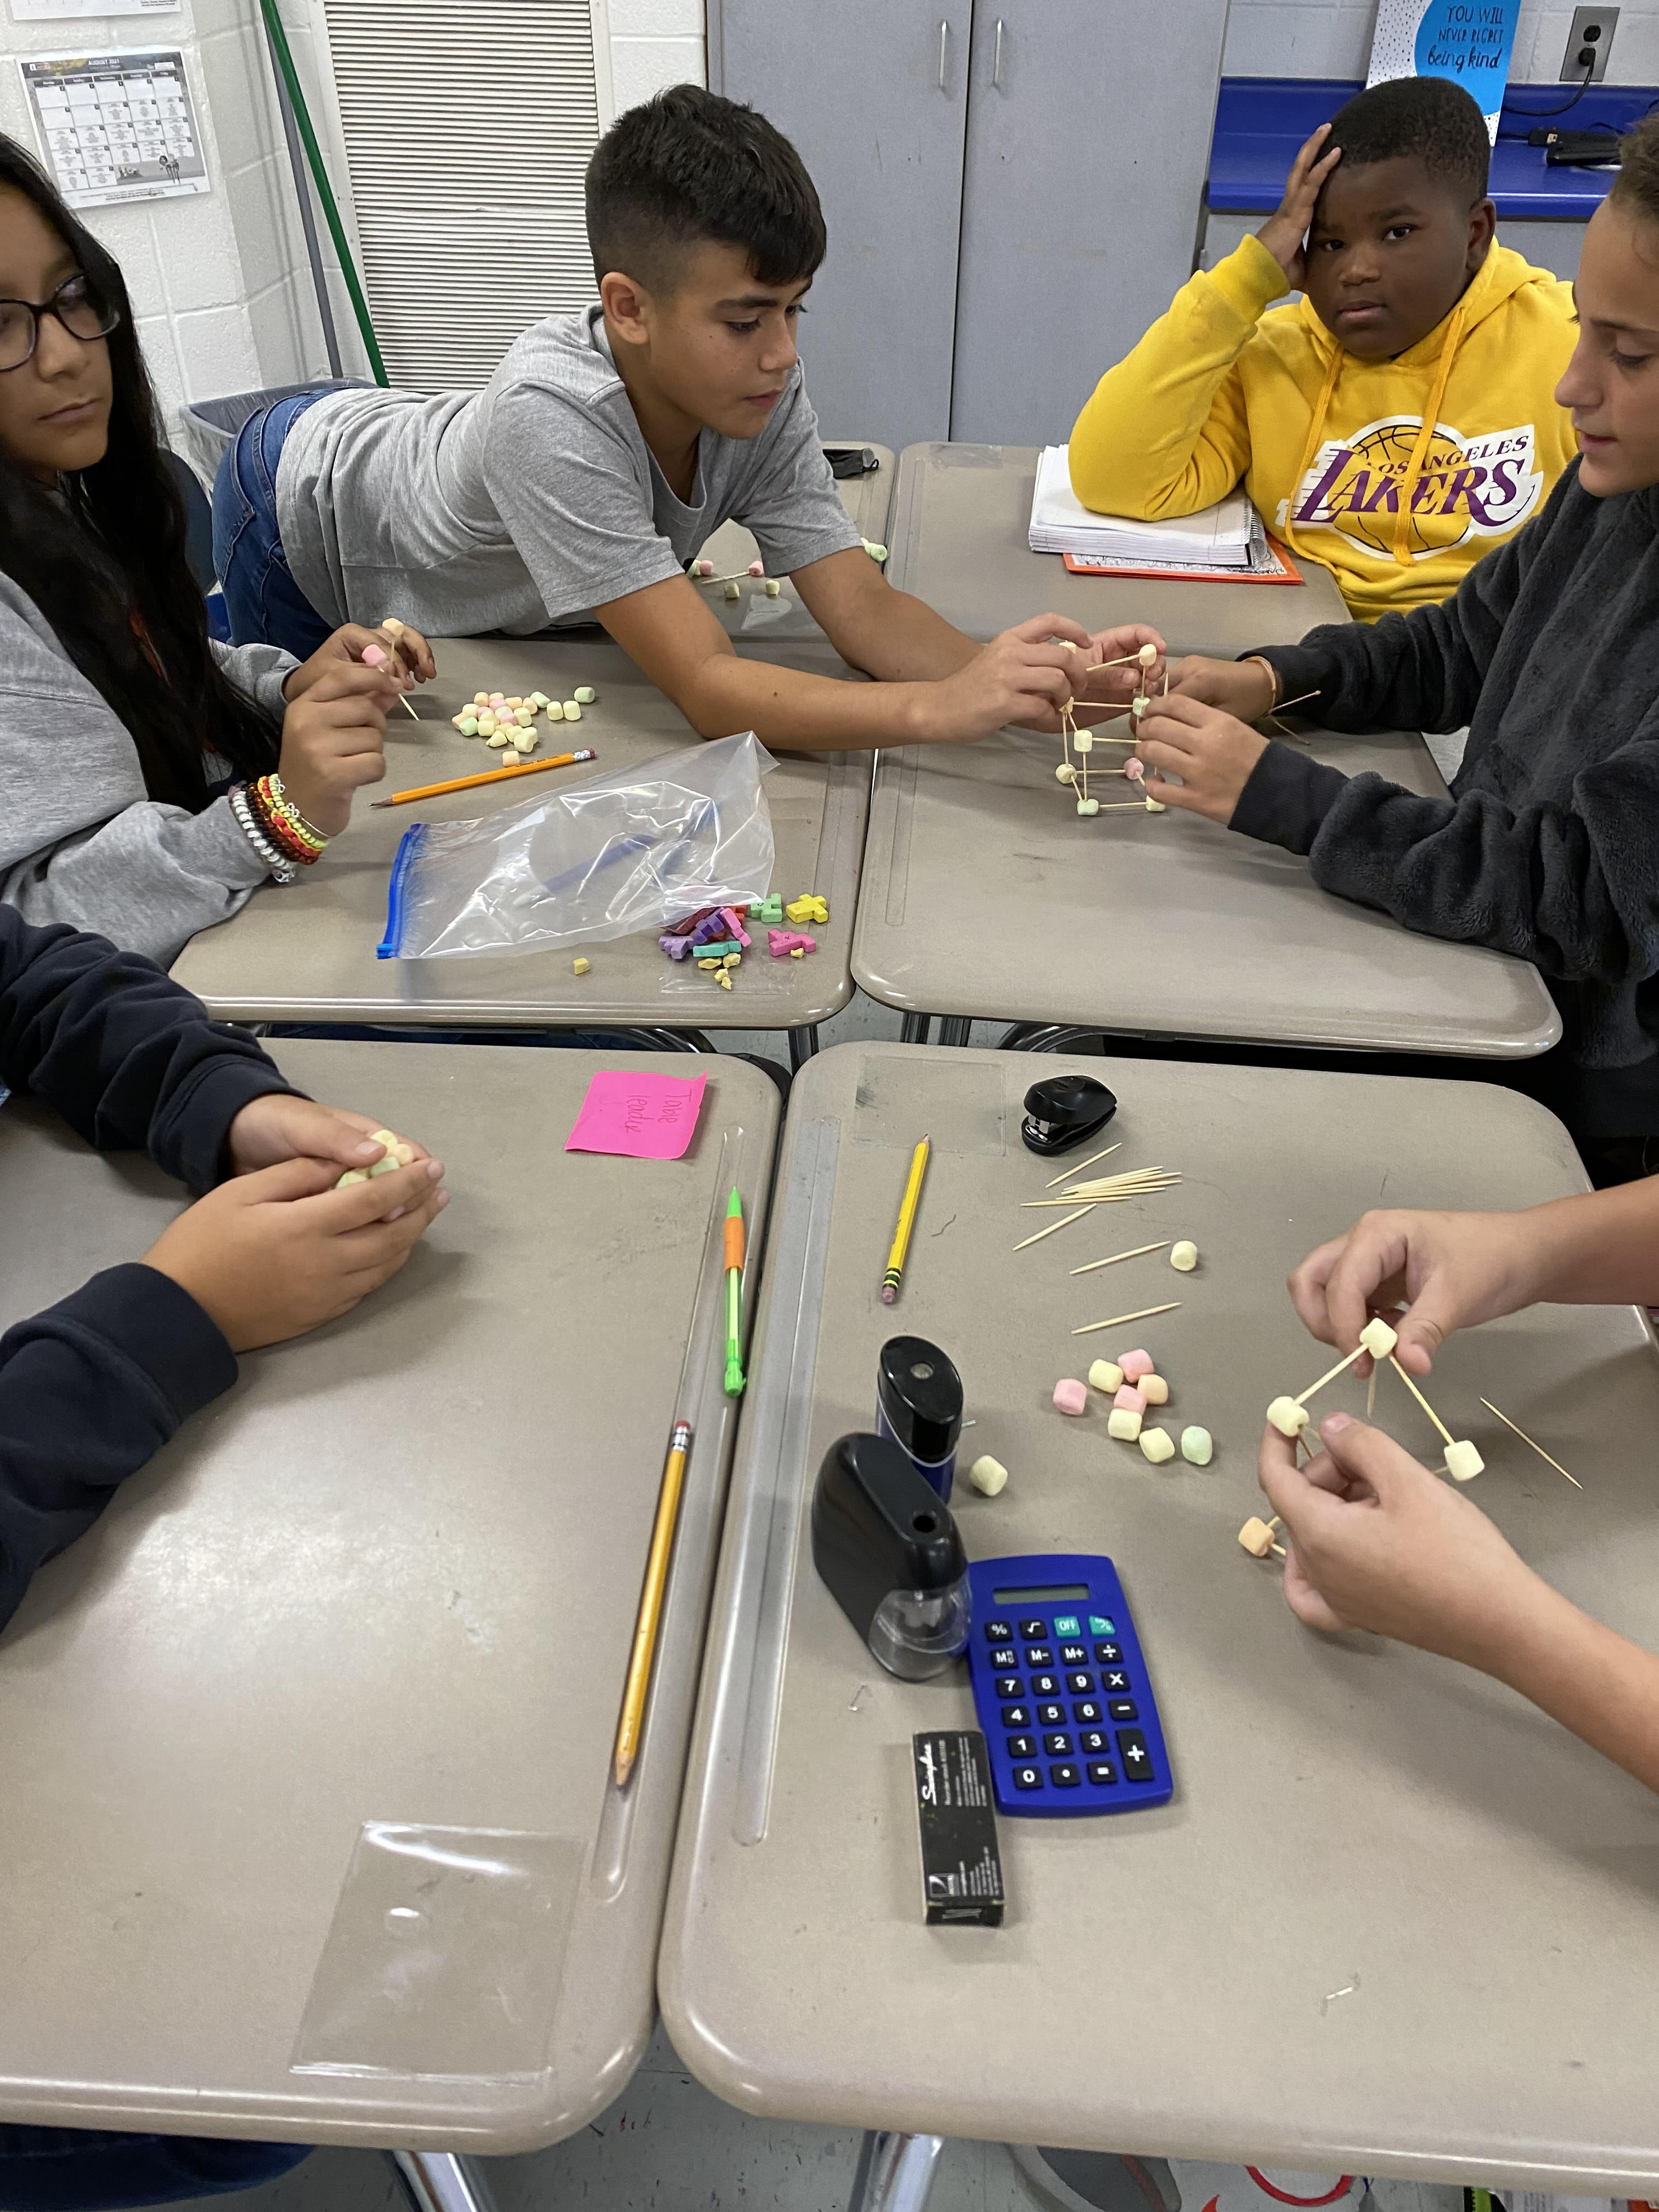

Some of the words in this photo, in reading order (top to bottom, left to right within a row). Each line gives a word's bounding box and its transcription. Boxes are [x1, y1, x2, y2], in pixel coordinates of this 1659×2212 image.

[1448, 5, 1474, 22] YOU
[1479, 7, 1503, 24] WILL
[1438, 27, 1467, 42] NEVER
[1471, 27, 1504, 43] REGRET
[1428, 44, 1465, 74] being
[1468, 45, 1503, 69] kind
[1368, 461, 1410, 475] OS
[1290, 448, 1536, 527] LAKERS
[658, 1088, 692, 1123] Table
[1005, 1679, 1016, 1692] 7
[1041, 1677, 1052, 1690] 8
[1076, 1675, 1087, 1688] 9
[1011, 1708, 1023, 1721] 4
[1047, 1706, 1058, 1719] 5
[1083, 1704, 1094, 1717] 6
[1017, 1738, 1027, 1751] 1
[1054, 1736, 1066, 1749] 2
[1090, 1734, 1102, 1747] 3
[1023, 1769, 1035, 1783] 0
